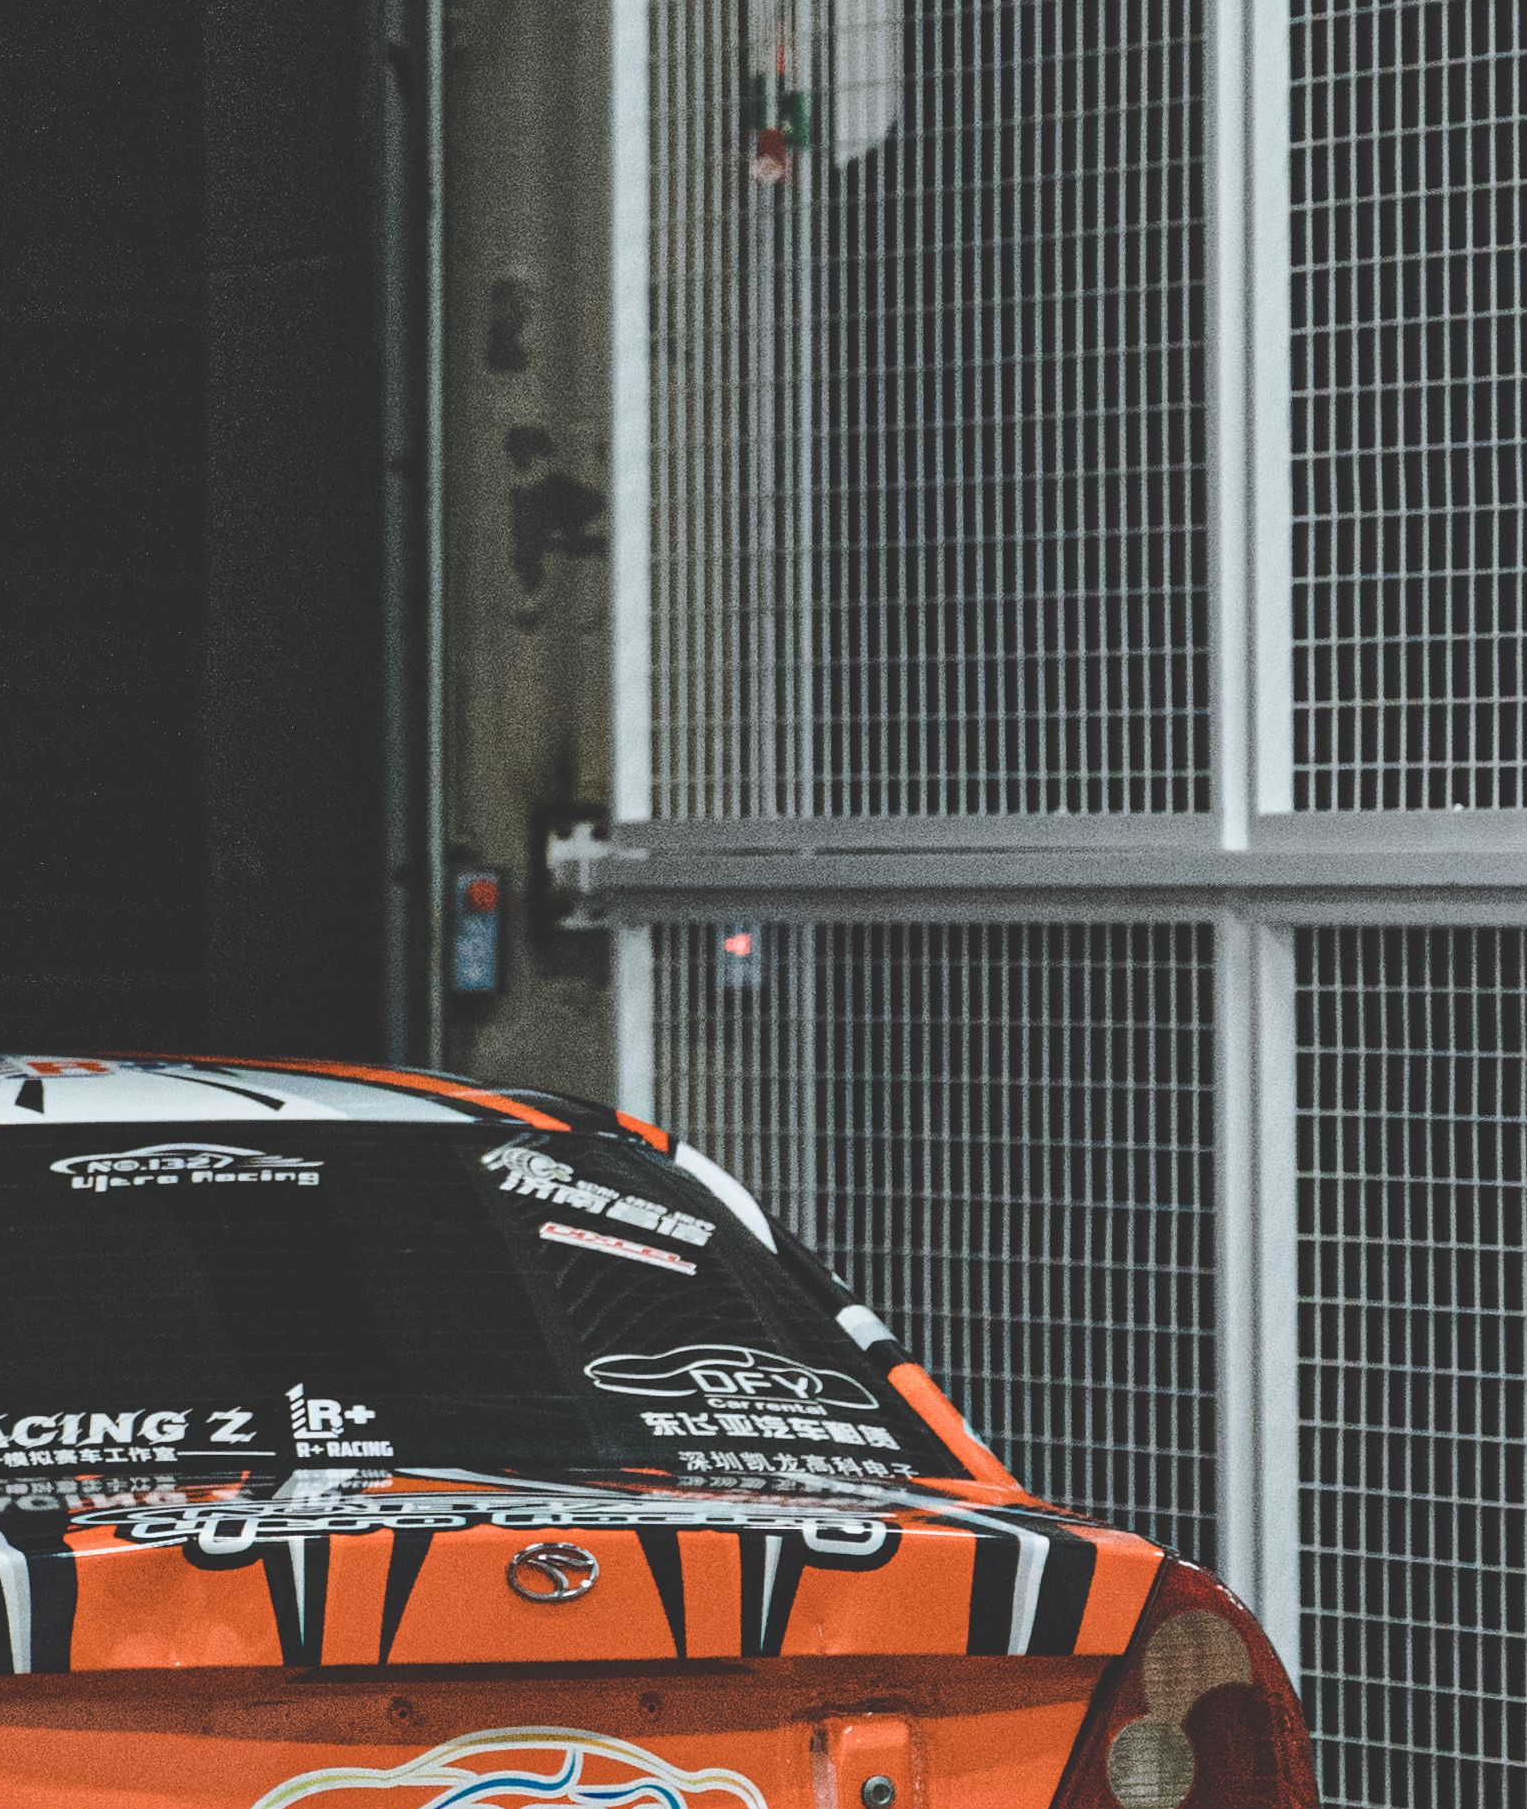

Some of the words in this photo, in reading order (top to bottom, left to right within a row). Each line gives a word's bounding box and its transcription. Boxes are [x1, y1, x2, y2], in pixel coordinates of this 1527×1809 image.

[689, 1369, 809, 1398] DFY
[706, 1398, 751, 1411] Car
[754, 1400, 828, 1416] rental
[3, 1447, 178, 1468] 模拟赛车工作室
[328, 1440, 394, 1458] RACING
[677, 1451, 920, 1479] 深圳凯龙高科电子
